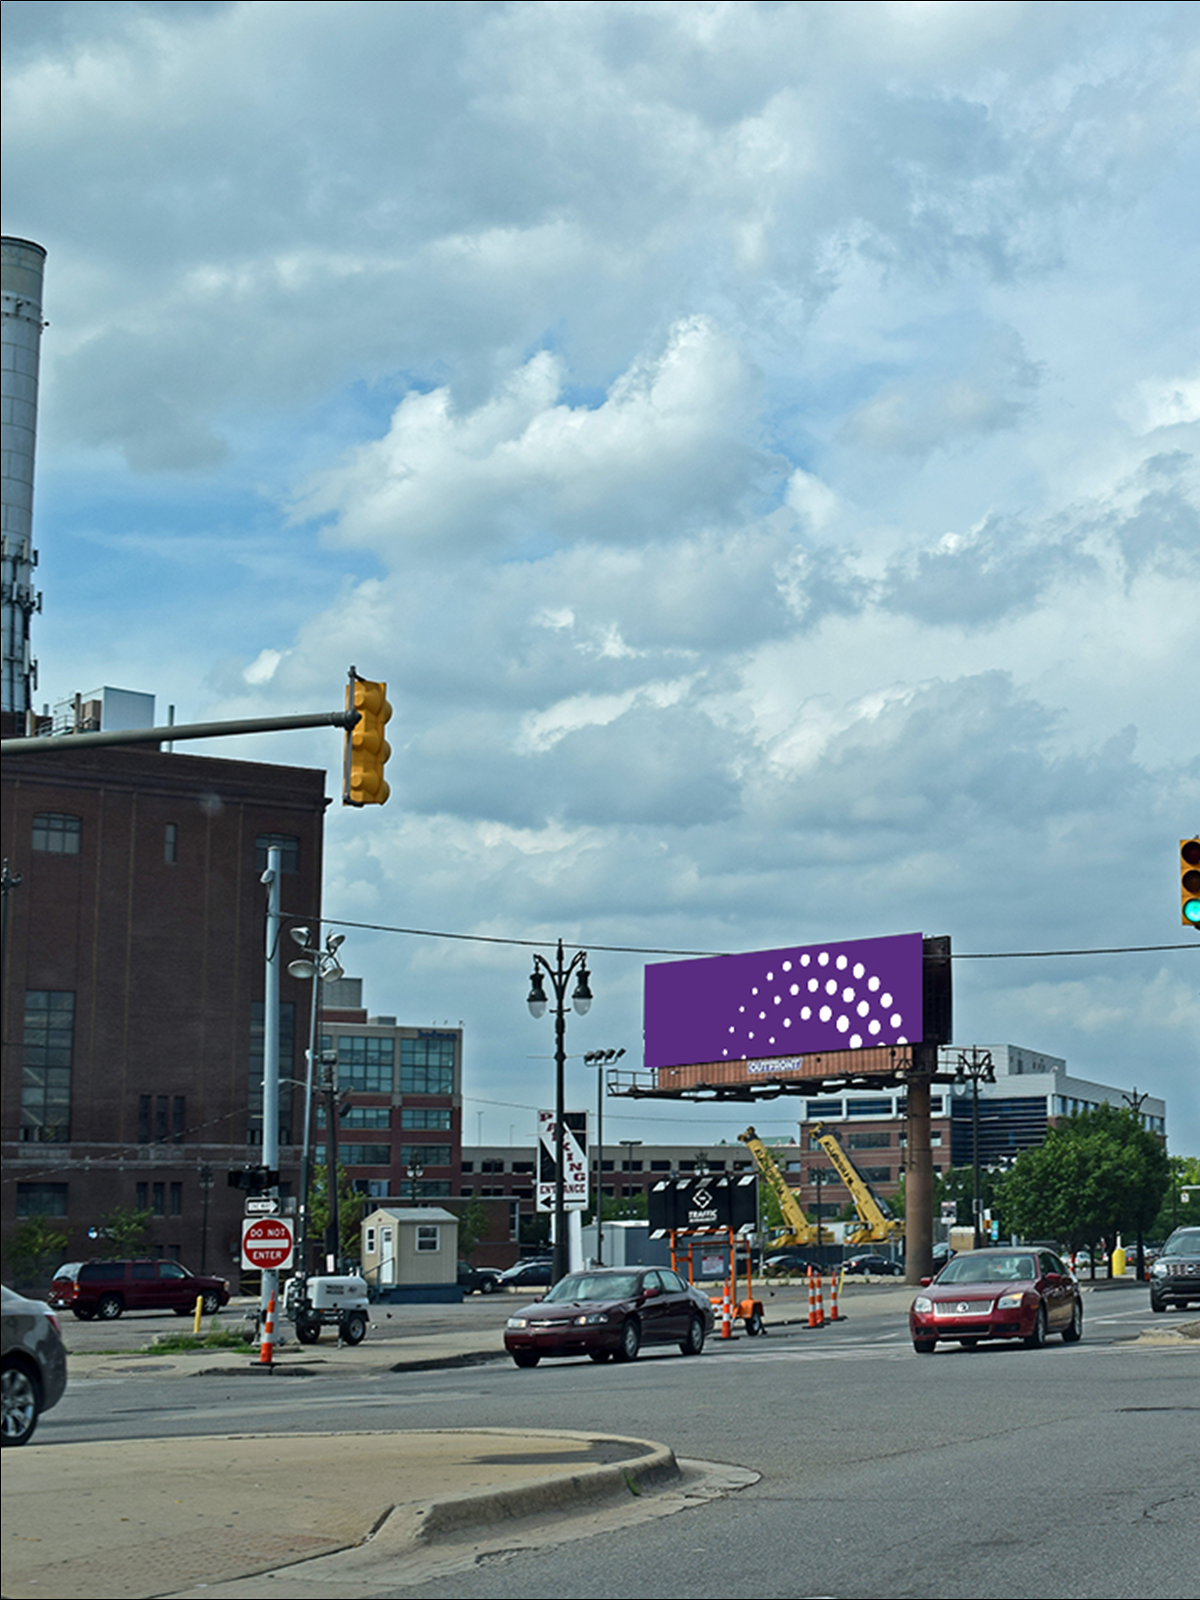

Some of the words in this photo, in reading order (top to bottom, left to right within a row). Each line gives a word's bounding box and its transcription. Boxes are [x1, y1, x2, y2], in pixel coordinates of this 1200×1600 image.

[540, 1184, 586, 1194] ENTANCE
[250, 1228, 263, 1238] DO
[267, 1227, 285, 1237] NOT
[252, 1250, 282, 1260] ENTER
